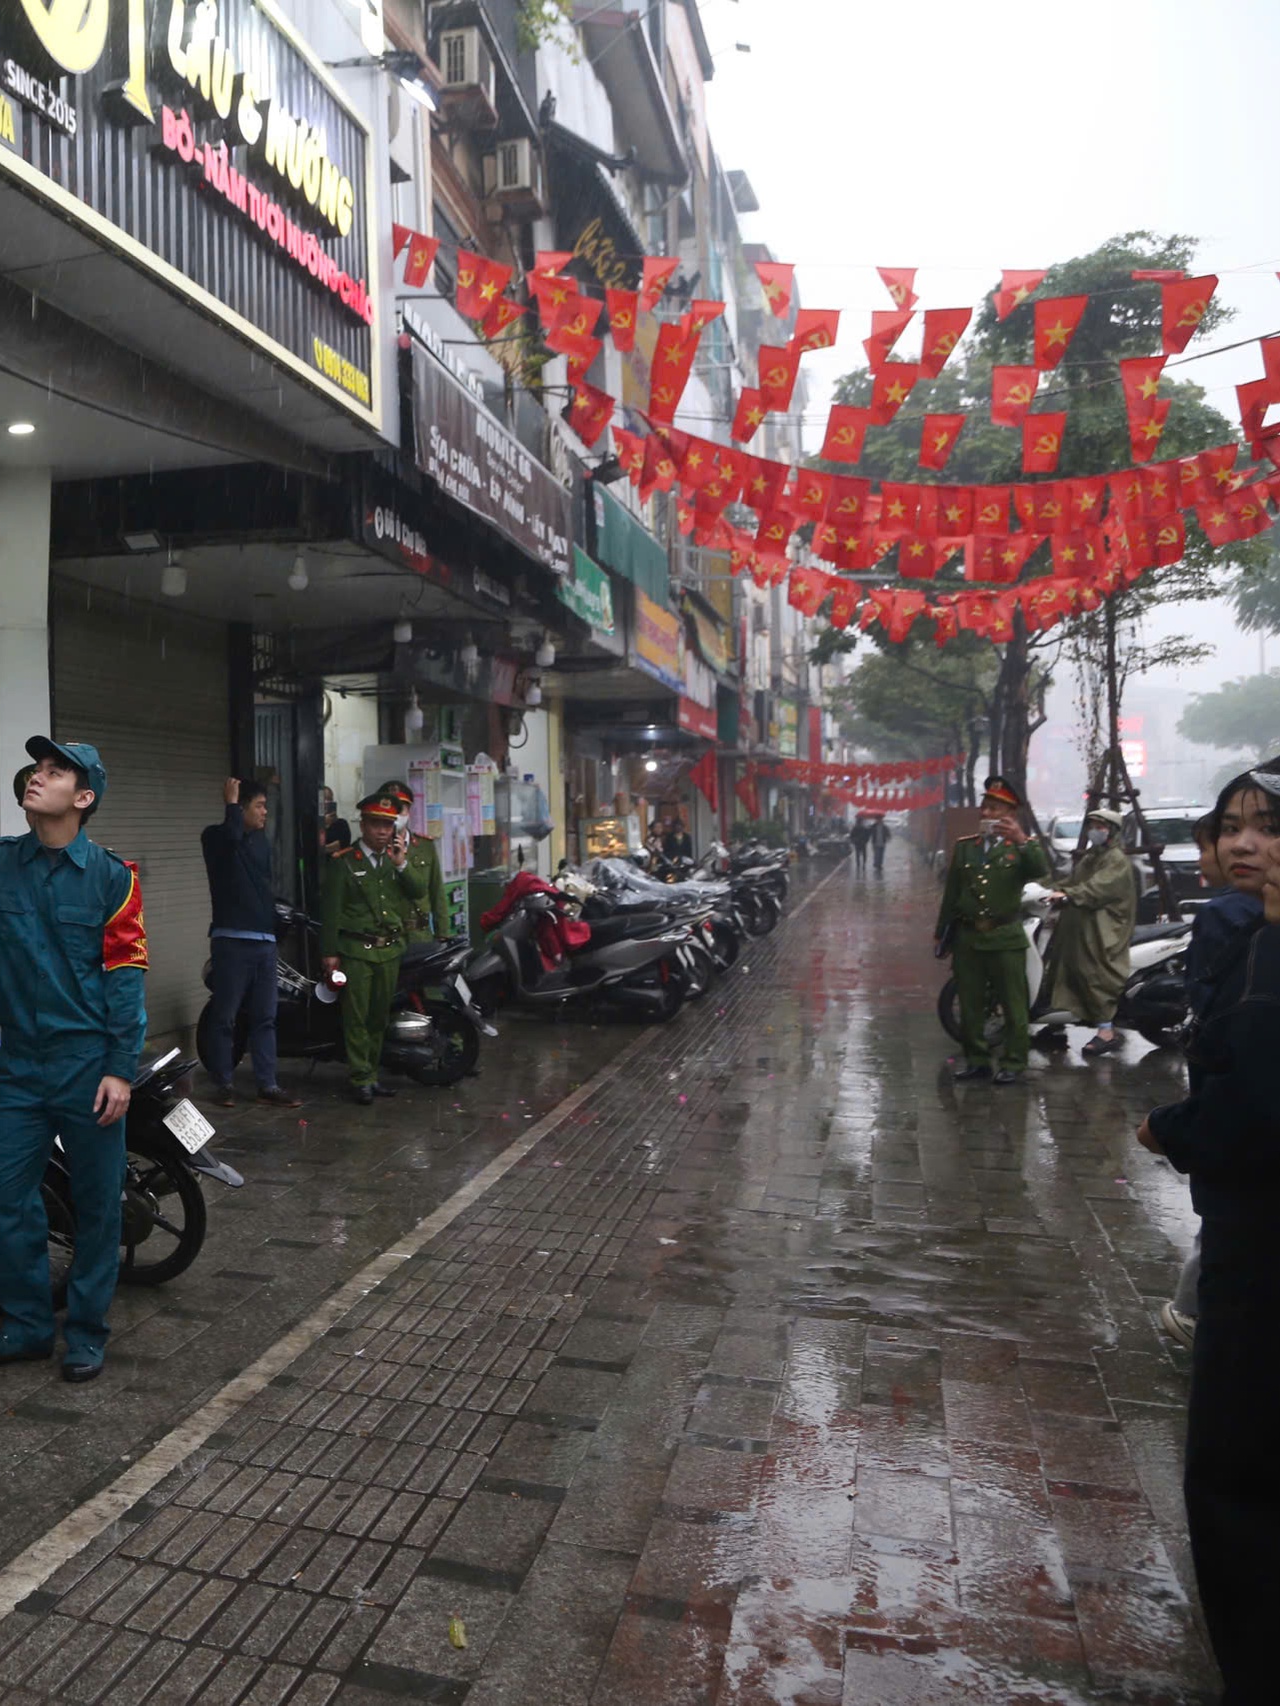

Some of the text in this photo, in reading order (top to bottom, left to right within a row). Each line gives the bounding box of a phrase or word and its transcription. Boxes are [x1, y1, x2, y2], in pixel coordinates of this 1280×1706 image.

[6, 59, 45, 110] SINCE
[47, 86, 77, 135] 2015
[265, 100, 354, 237] NƯỚNG
